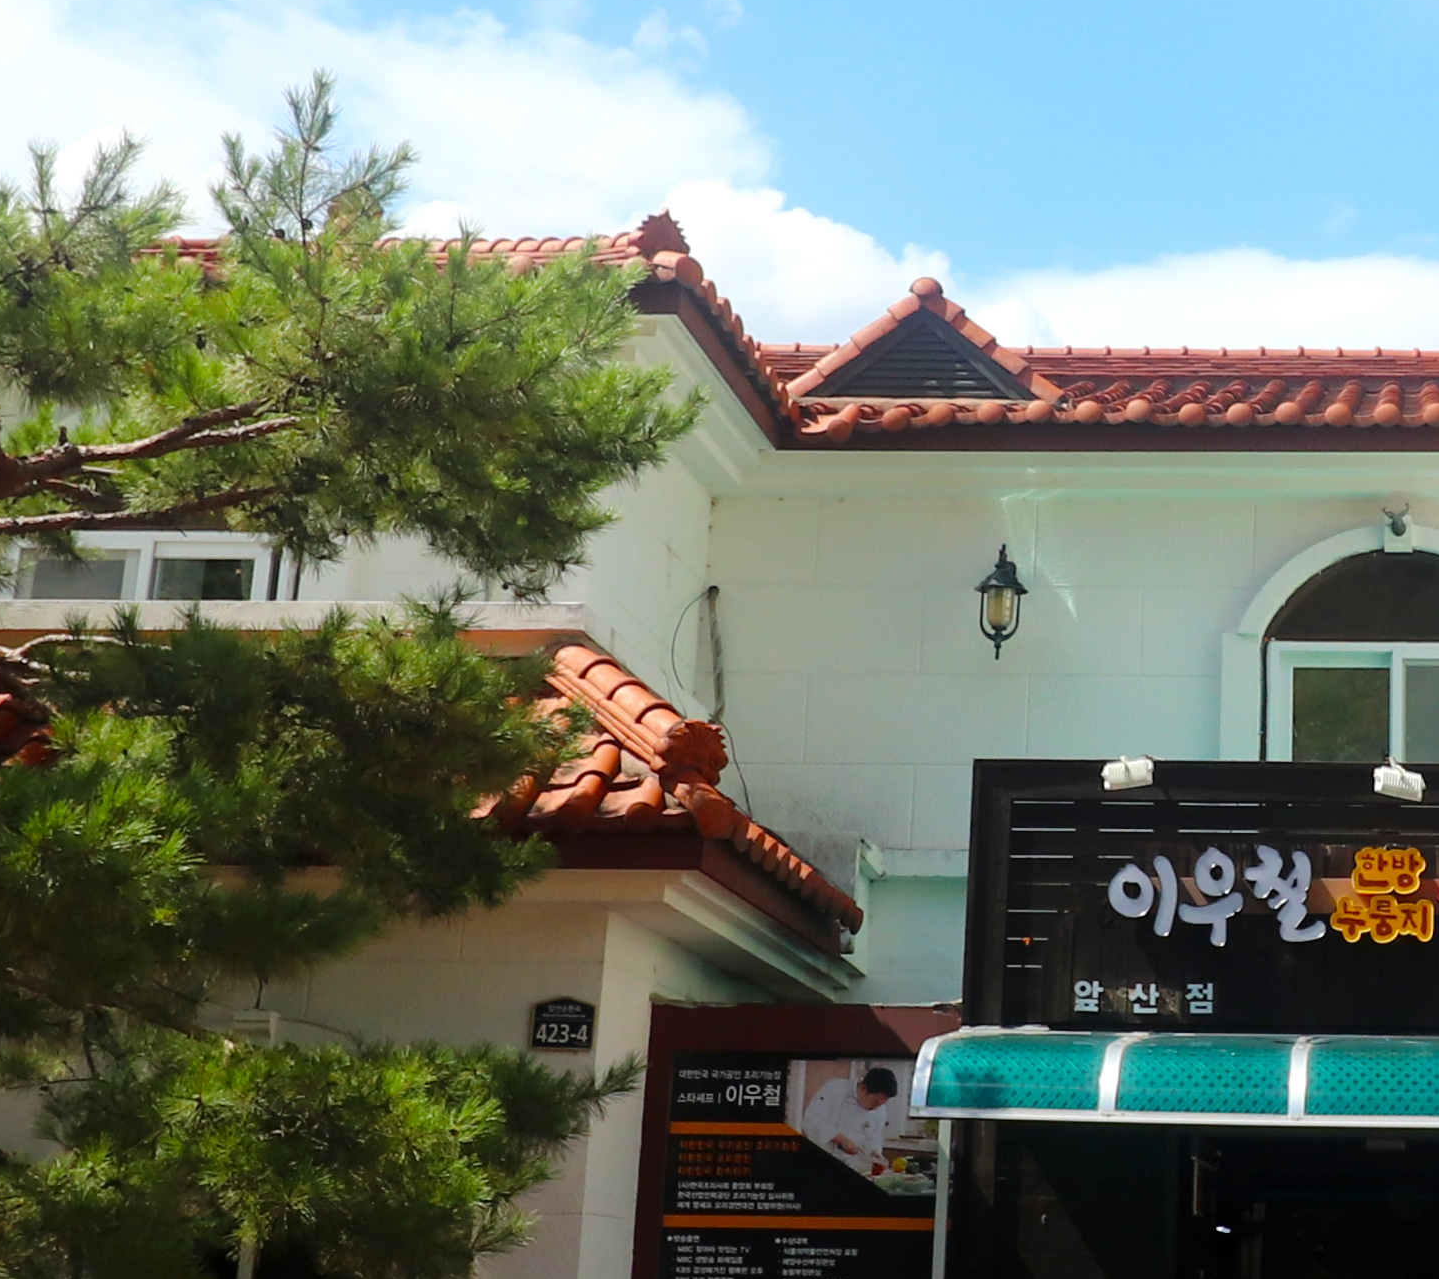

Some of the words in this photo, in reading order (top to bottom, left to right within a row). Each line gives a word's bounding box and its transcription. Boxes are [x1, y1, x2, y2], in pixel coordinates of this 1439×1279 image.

[1108, 845, 1326, 947] 이우철
[536, 1023, 588, 1043] 423-4
[726, 1084, 781, 1106] 이우철
